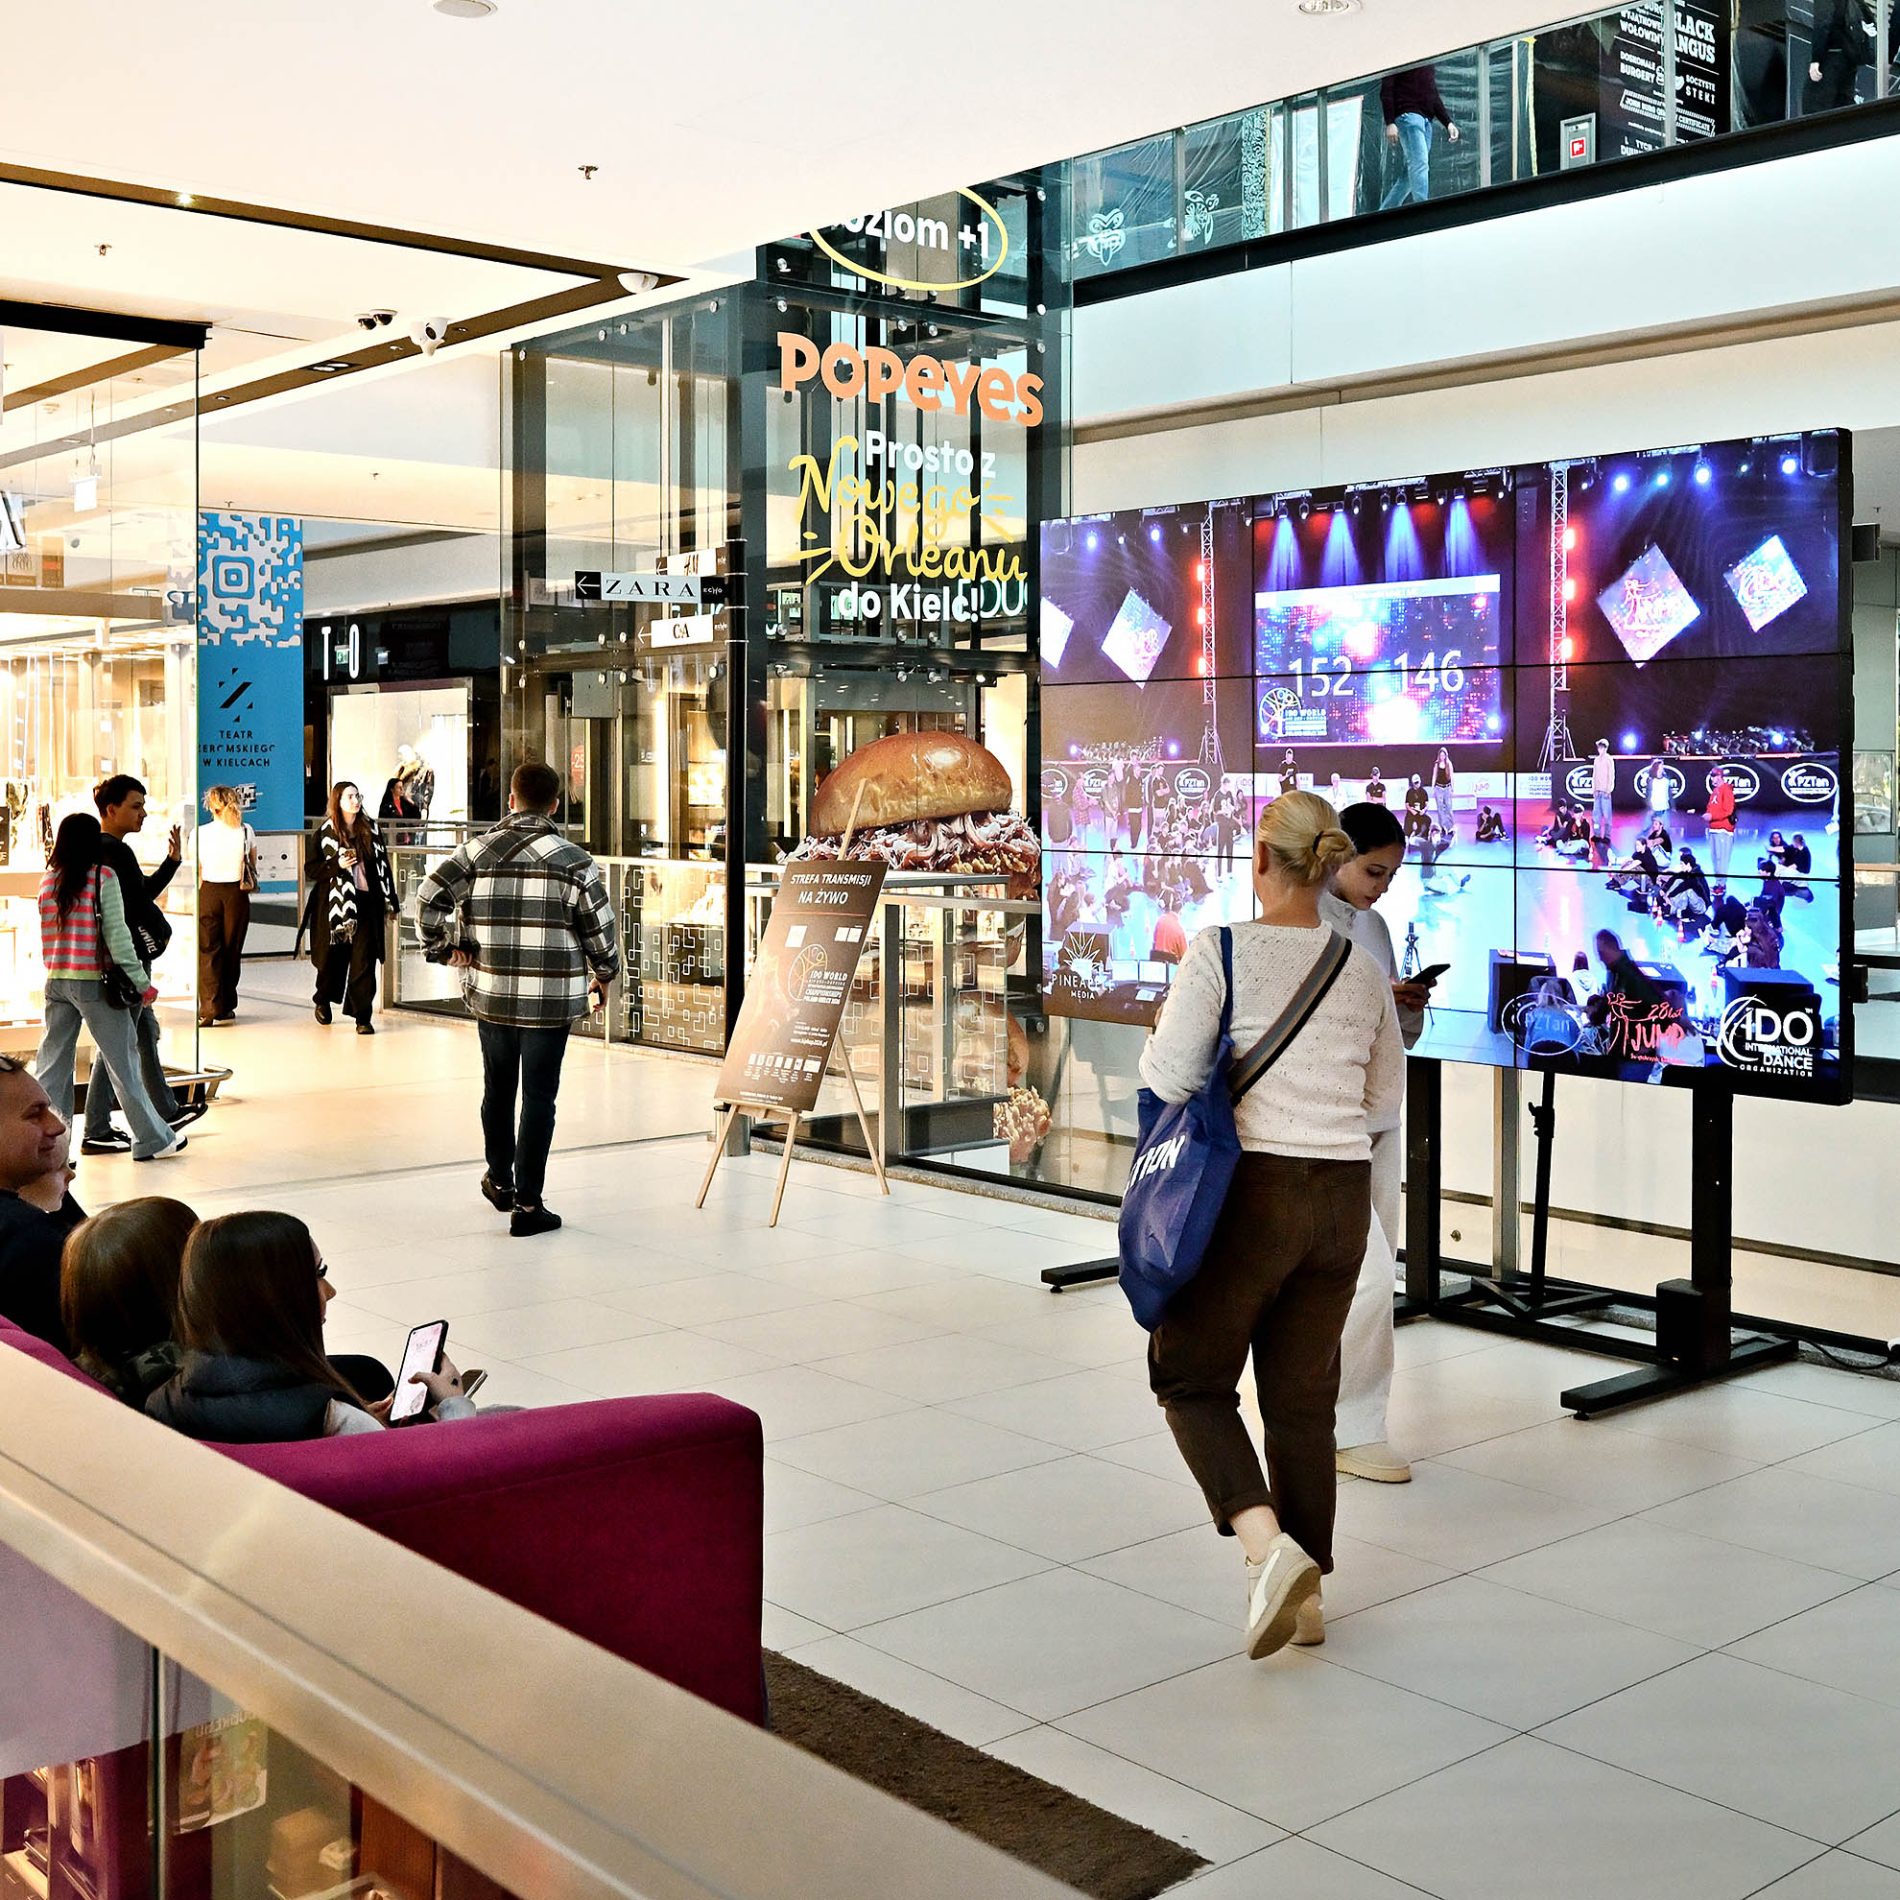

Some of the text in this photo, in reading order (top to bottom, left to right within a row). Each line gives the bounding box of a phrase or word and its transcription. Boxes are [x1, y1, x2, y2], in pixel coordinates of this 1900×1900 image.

[1685, 85, 1716, 105] STEKI
[844, 210, 949, 251] oziom
[865, 429, 997, 479] Prosto z
[788, 434, 980, 542] Nowego
[837, 513, 1028, 582] Orleanu
[605, 578, 723, 598] ZARA ECHO
[837, 581, 882, 619] do
[1288, 649, 1465, 698] 152 146
[219, 730, 254, 740] TEATR
[203, 758, 271, 767] W KIELCACH
[790, 873, 872, 888] STREFA TRANSMISJI
[798, 888, 849, 905] NA ŻYWO
[823, 970, 848, 981] WORLD
[1070, 989, 1096, 1000] MEDIA
[1647, 1002, 1669, 1020] 28
[1630, 1022, 1686, 1052] JUMP
[1739, 1063, 1813, 1077] ORGANIZATION
[1763, 1053, 1813, 1070] DANCE
